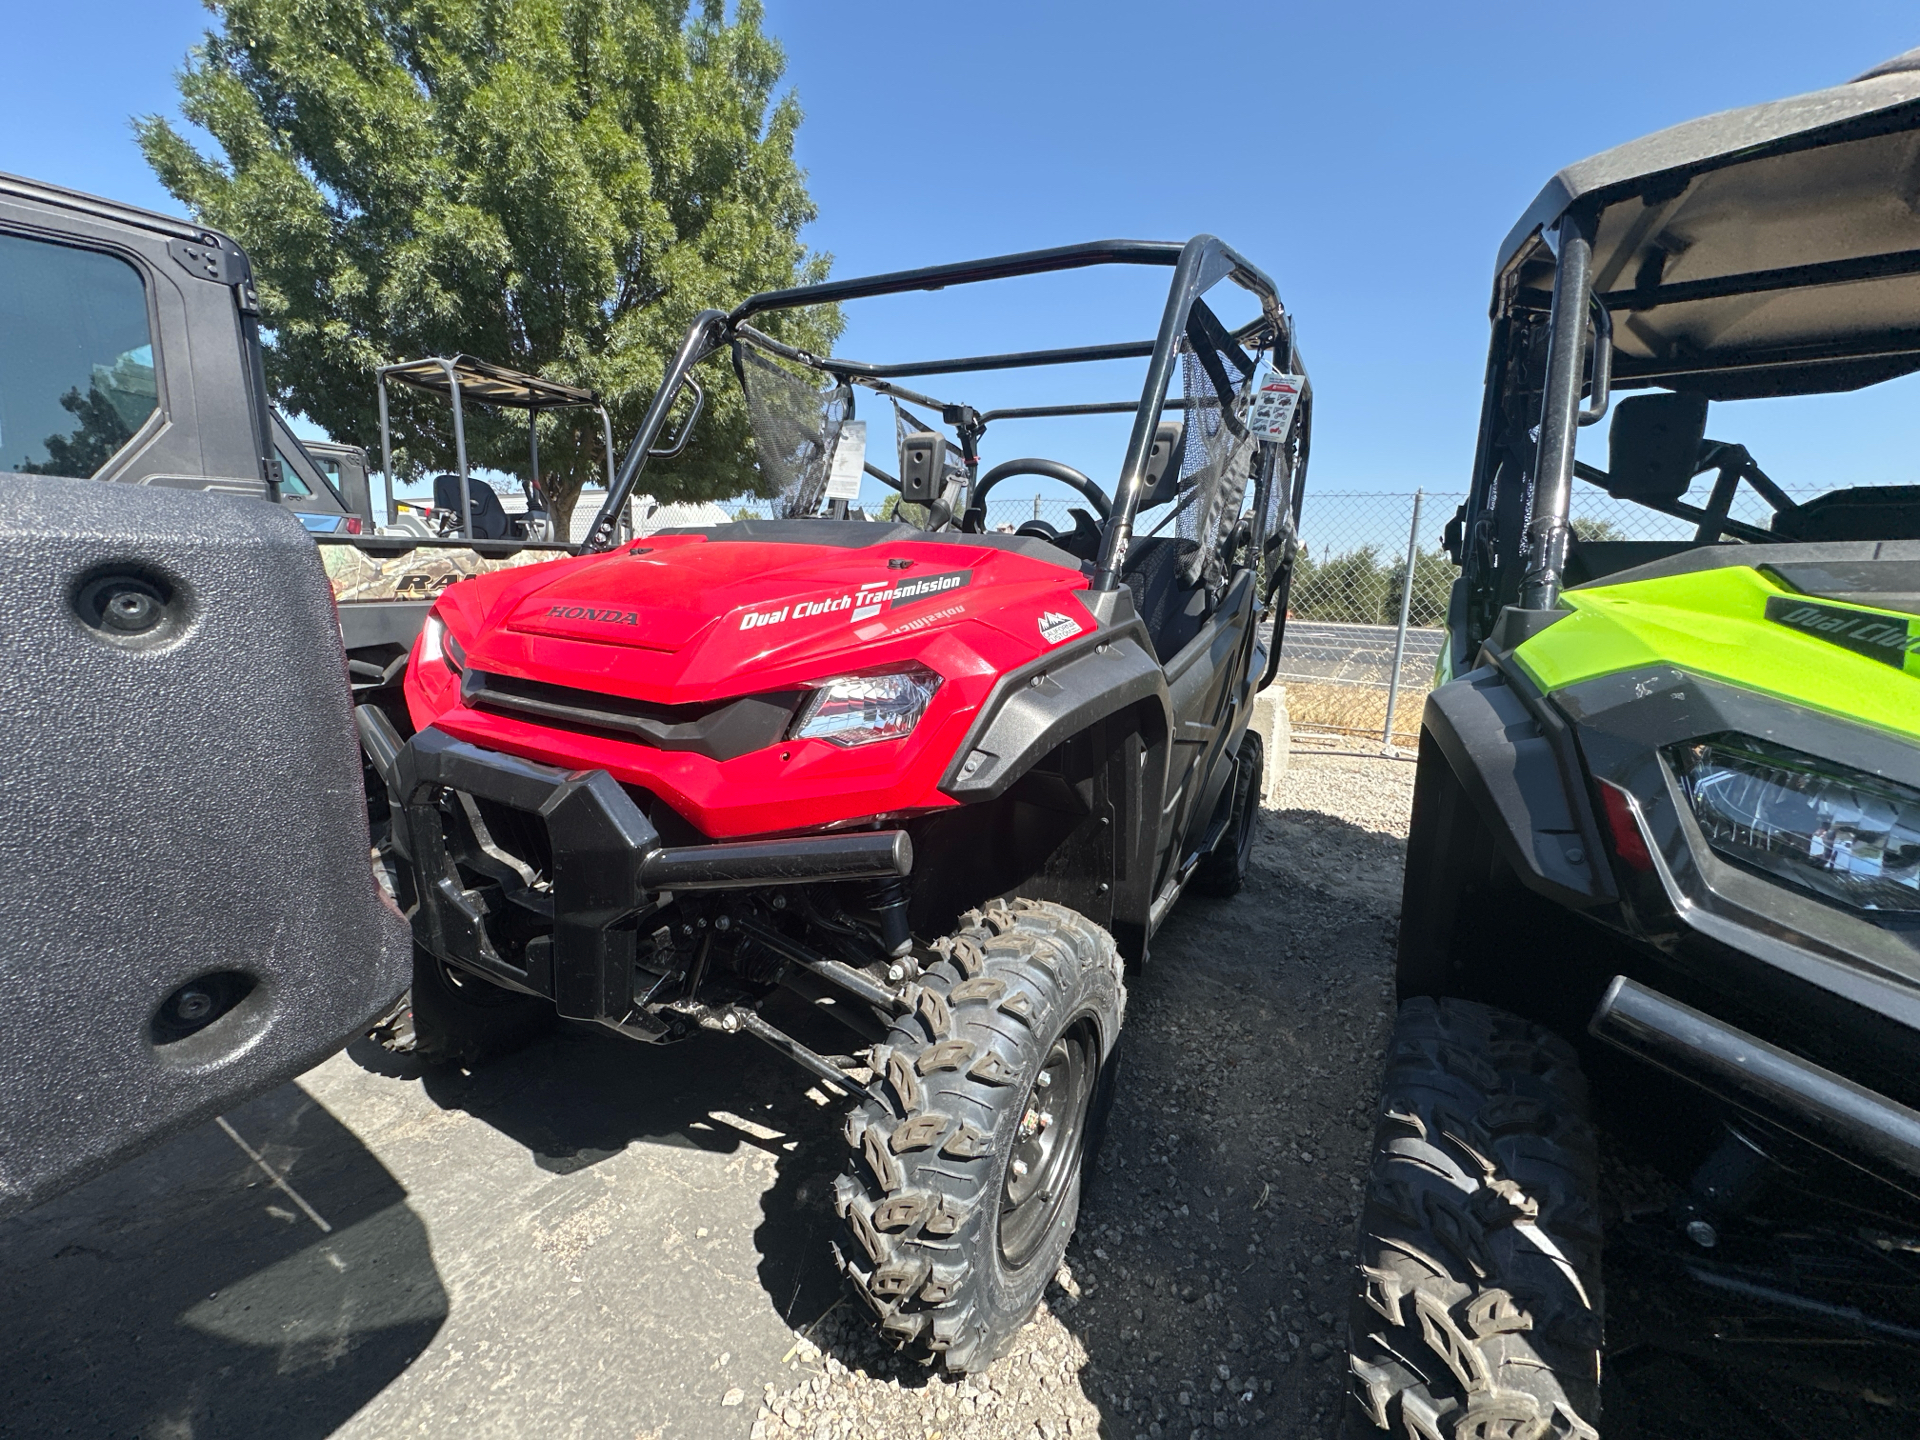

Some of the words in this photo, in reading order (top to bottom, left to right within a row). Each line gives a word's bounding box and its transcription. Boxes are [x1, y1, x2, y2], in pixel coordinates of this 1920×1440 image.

[739, 606, 790, 631] Dual
[792, 596, 852, 619] Clutch
[855, 575, 961, 606] Transmission
[547, 605, 639, 626] HONDA
[1781, 607, 1861, 633] Dual
[1043, 621, 1076, 637] CALIFORNIA
